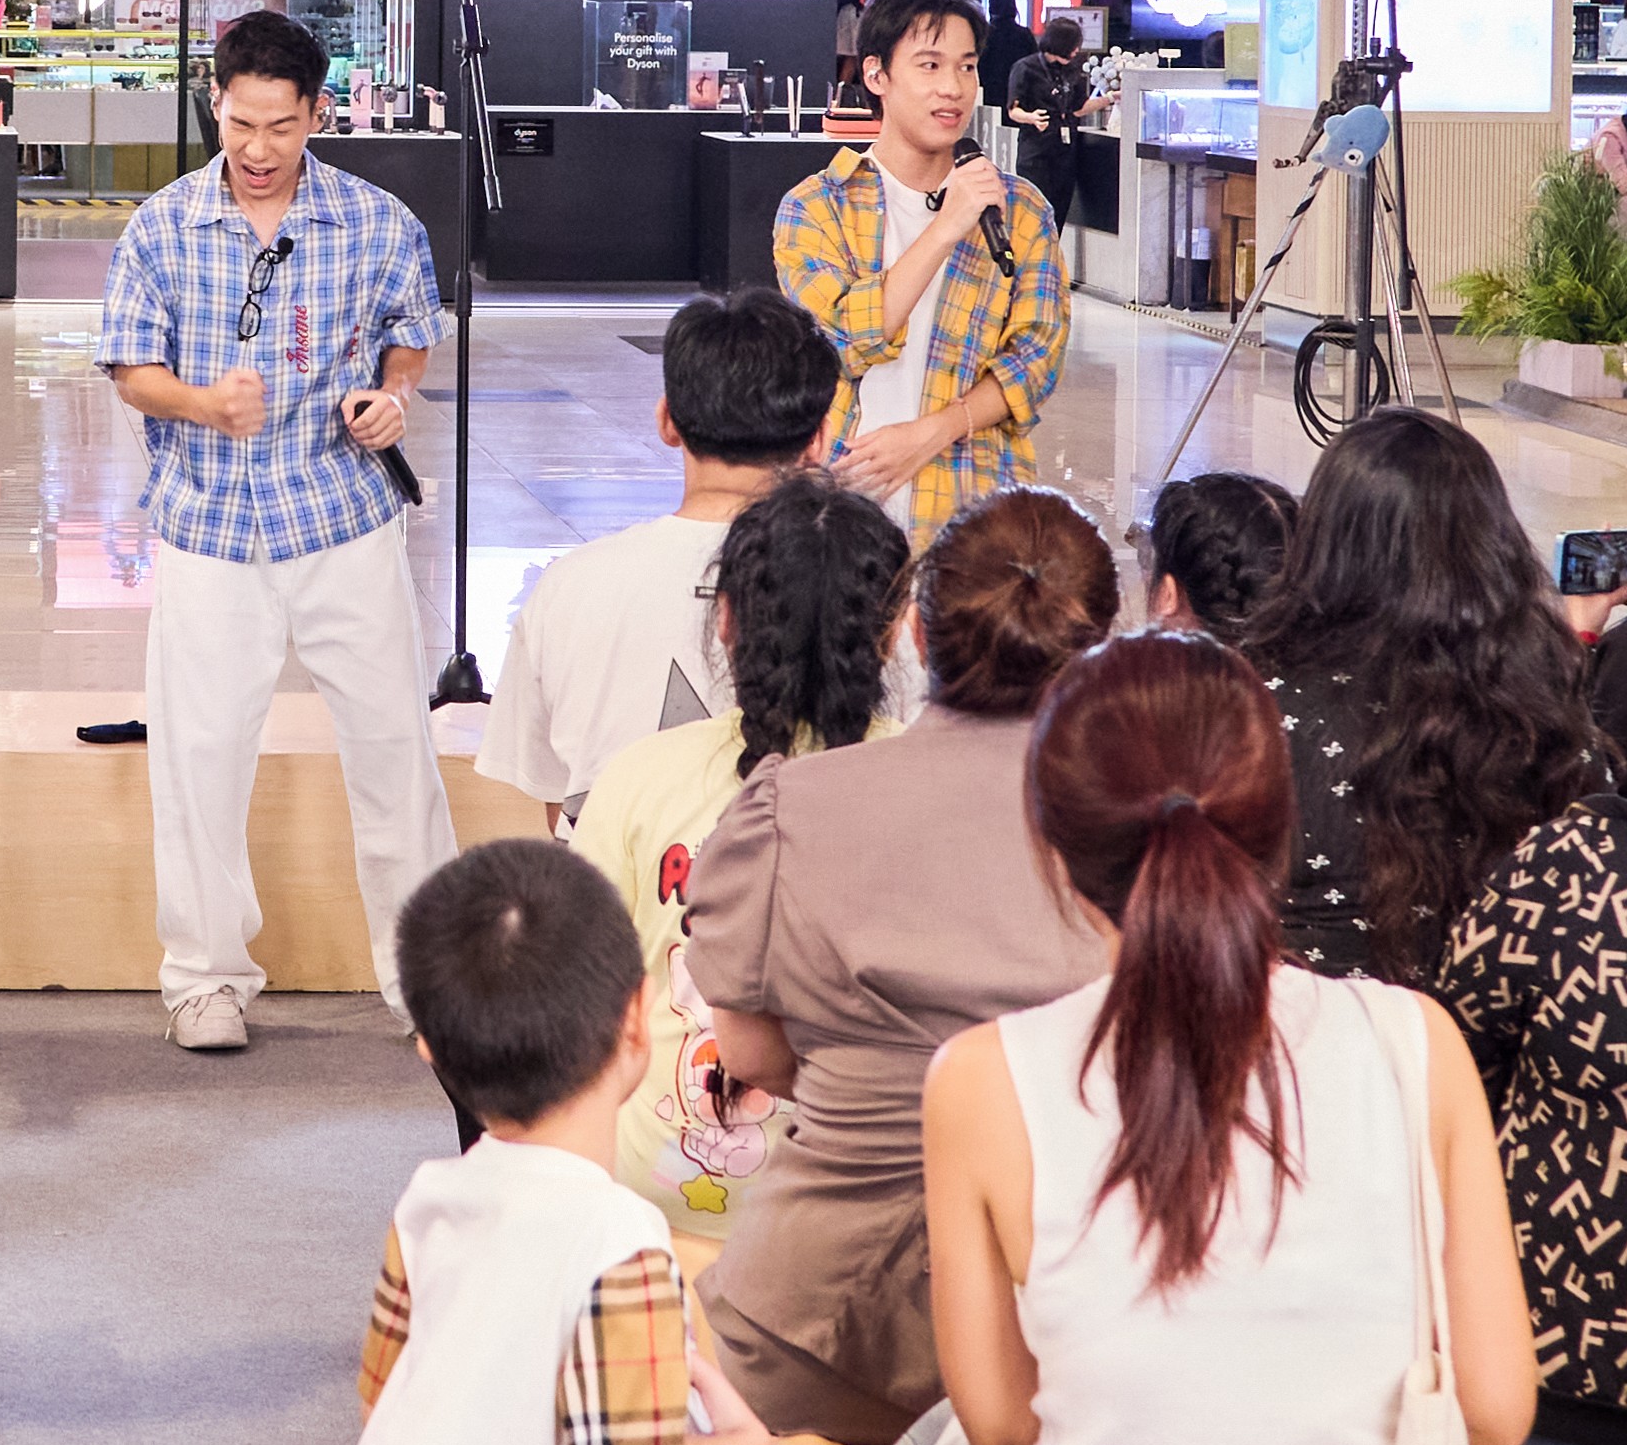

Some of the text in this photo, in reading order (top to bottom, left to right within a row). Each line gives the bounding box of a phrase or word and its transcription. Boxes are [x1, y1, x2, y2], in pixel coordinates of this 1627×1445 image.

[614, 33, 673, 44] Personalise
[610, 44, 677, 58] your gift with
[627, 58, 660, 71] Dyson
